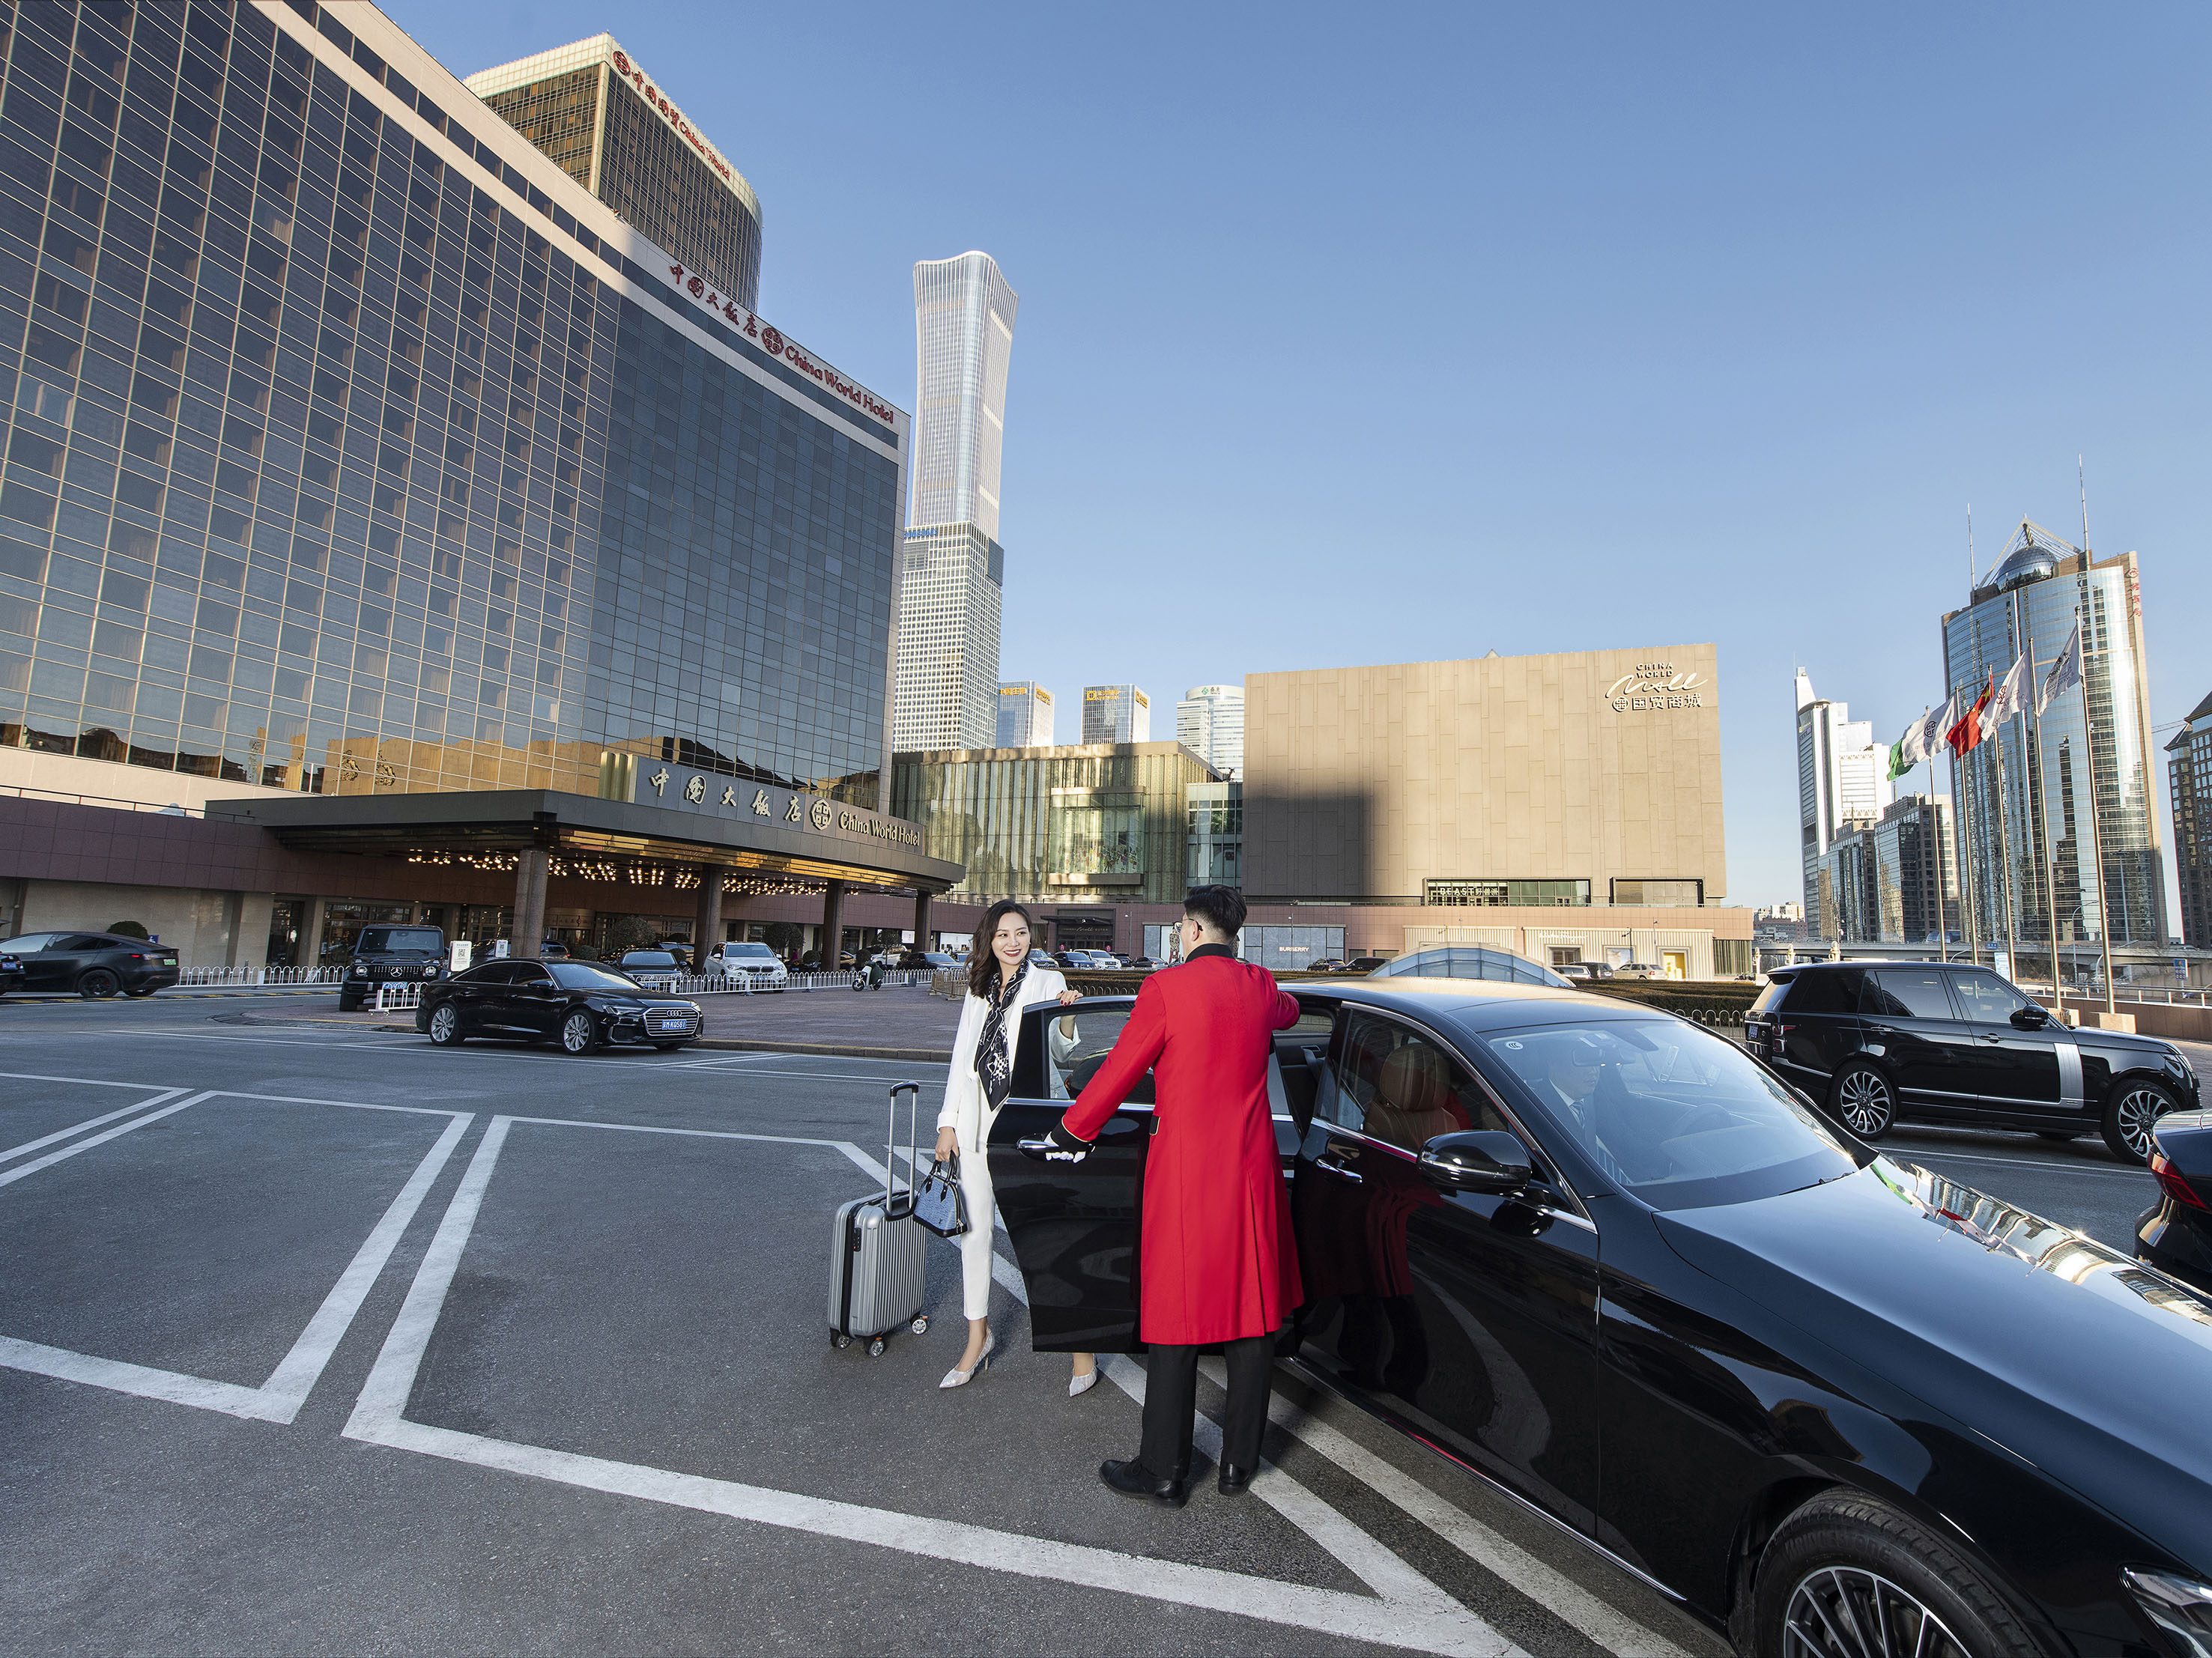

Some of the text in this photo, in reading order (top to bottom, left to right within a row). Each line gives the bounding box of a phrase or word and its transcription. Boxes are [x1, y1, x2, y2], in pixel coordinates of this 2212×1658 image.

[679, 121, 730, 180] China World
[784, 345, 894, 424] China World Hotel
[1636, 661, 1673, 671] CHINA
[1636, 669, 1673, 679] WORLD
[1631, 693, 1703, 711] 国贸商城
[839, 810, 921, 847] China World Hotel
[1440, 887, 1474, 896] BEAST
